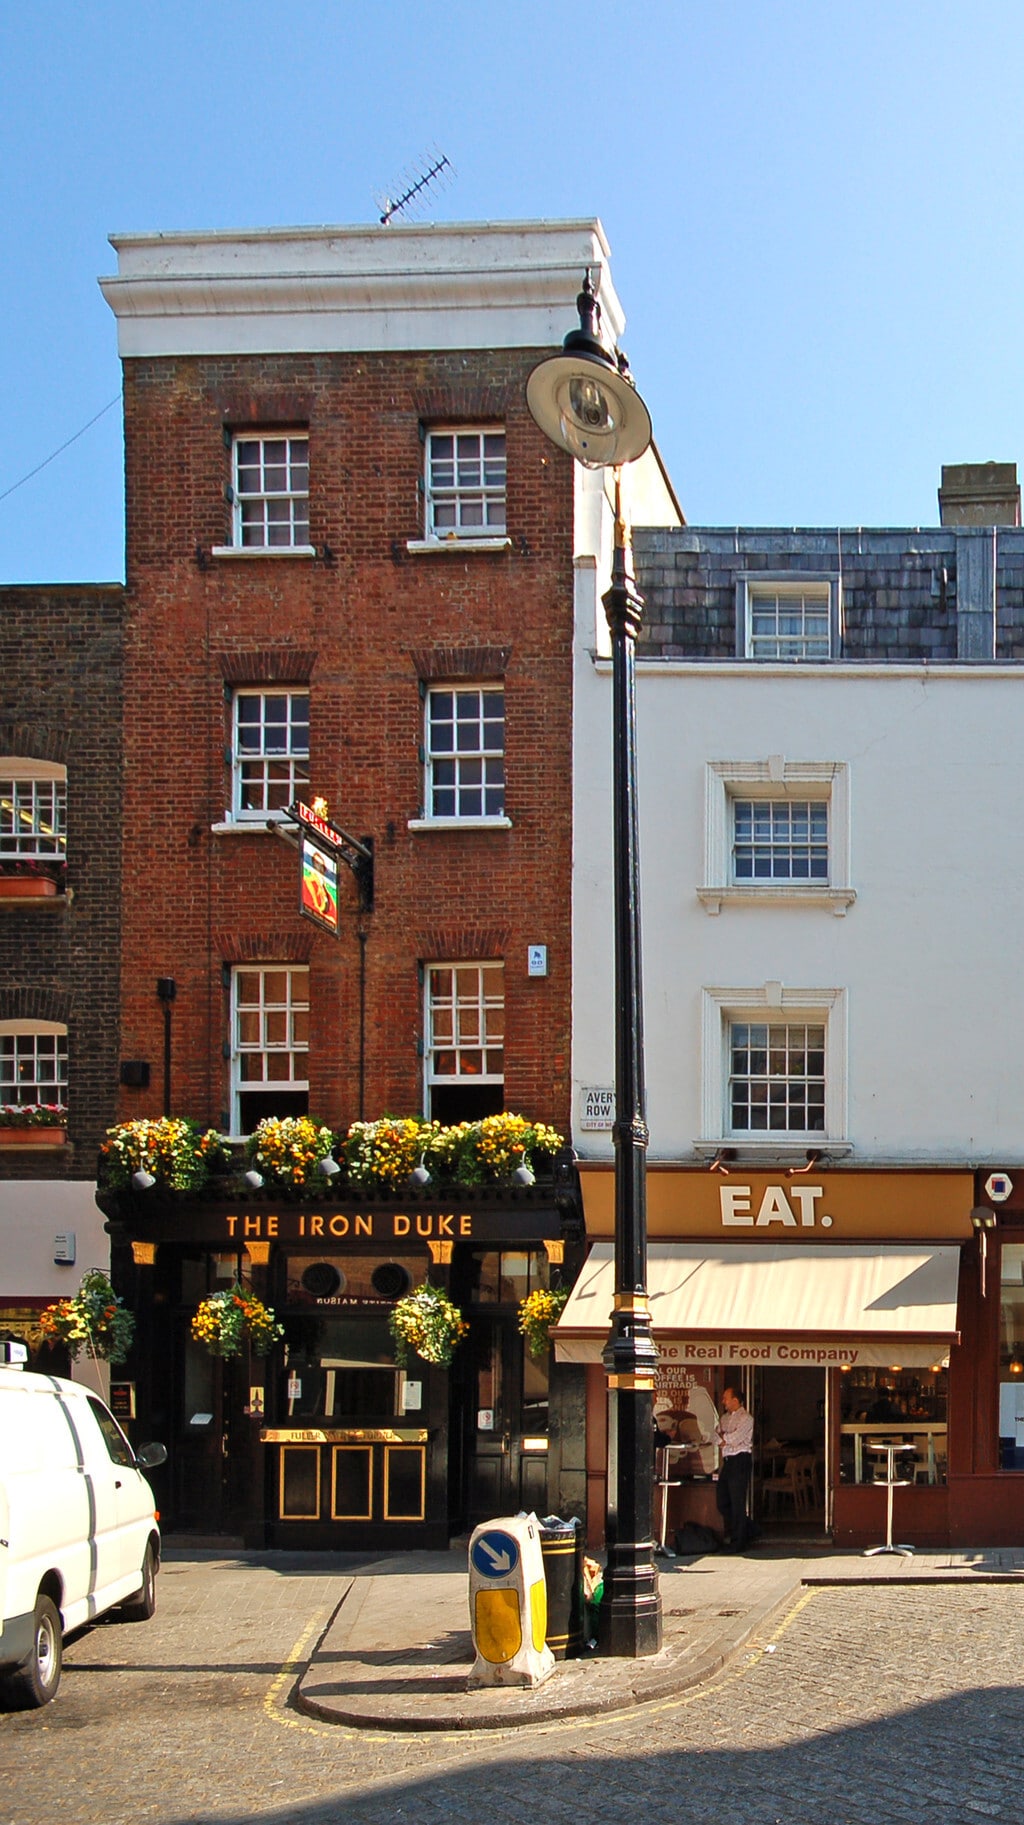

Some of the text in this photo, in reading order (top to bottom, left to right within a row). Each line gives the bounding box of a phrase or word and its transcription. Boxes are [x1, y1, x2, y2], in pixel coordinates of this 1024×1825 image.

[586, 1092, 616, 1104] AVER
[586, 1105, 611, 1116] ROW
[719, 1185, 834, 1228] EAT.
[226, 1214, 473, 1237] THE IRON DUKE
[658, 1344, 859, 1363] he Real Food Company
[666, 1367, 687, 1375] OUR
[654, 1374, 696, 1382] OFFEE IS
